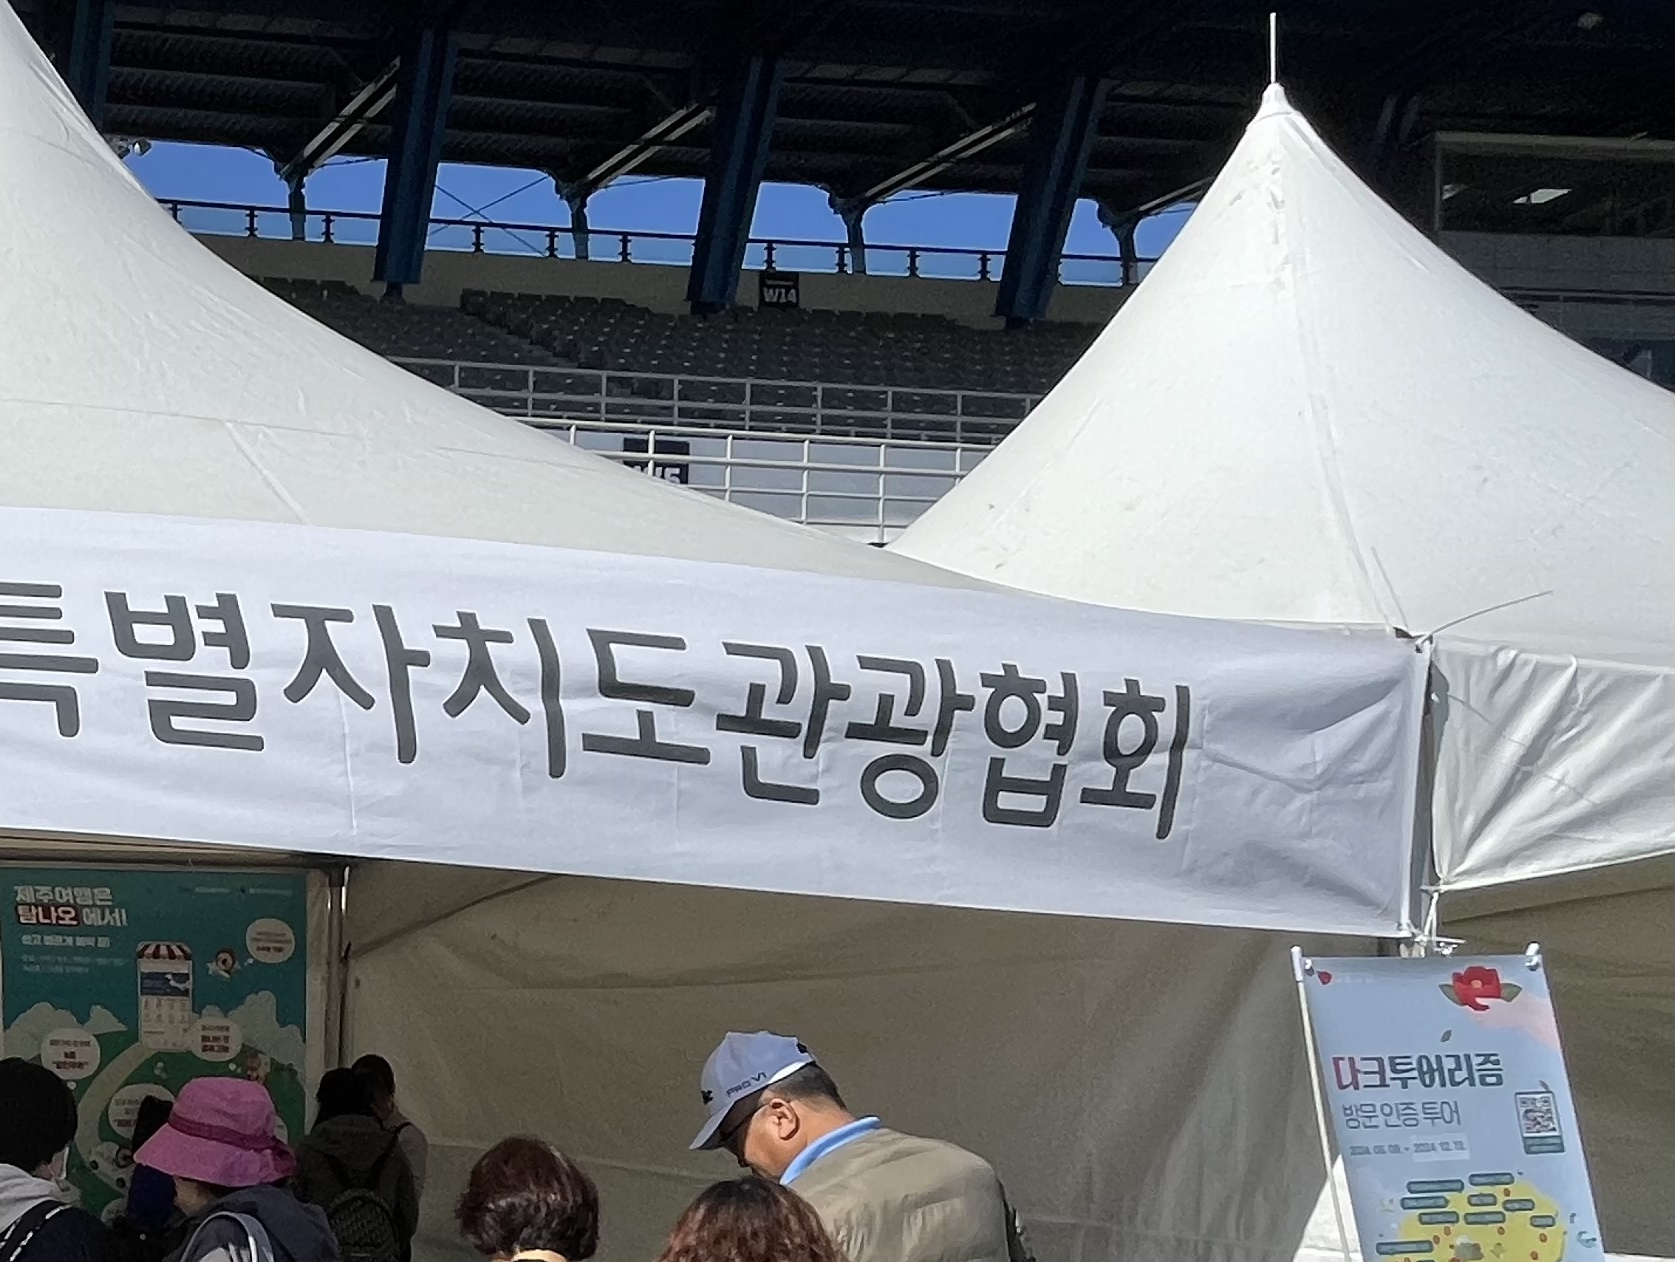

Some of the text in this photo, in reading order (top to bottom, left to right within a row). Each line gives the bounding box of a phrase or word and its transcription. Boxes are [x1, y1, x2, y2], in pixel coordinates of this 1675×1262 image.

[763, 287, 797, 303] W14
[14, 885, 114, 907] 제주여행은
[17, 905, 79, 926] 탐나오
[1332, 1053, 1505, 1091] 다크투어리즘
[1342, 1100, 1462, 1130] 방문 인증 투어
